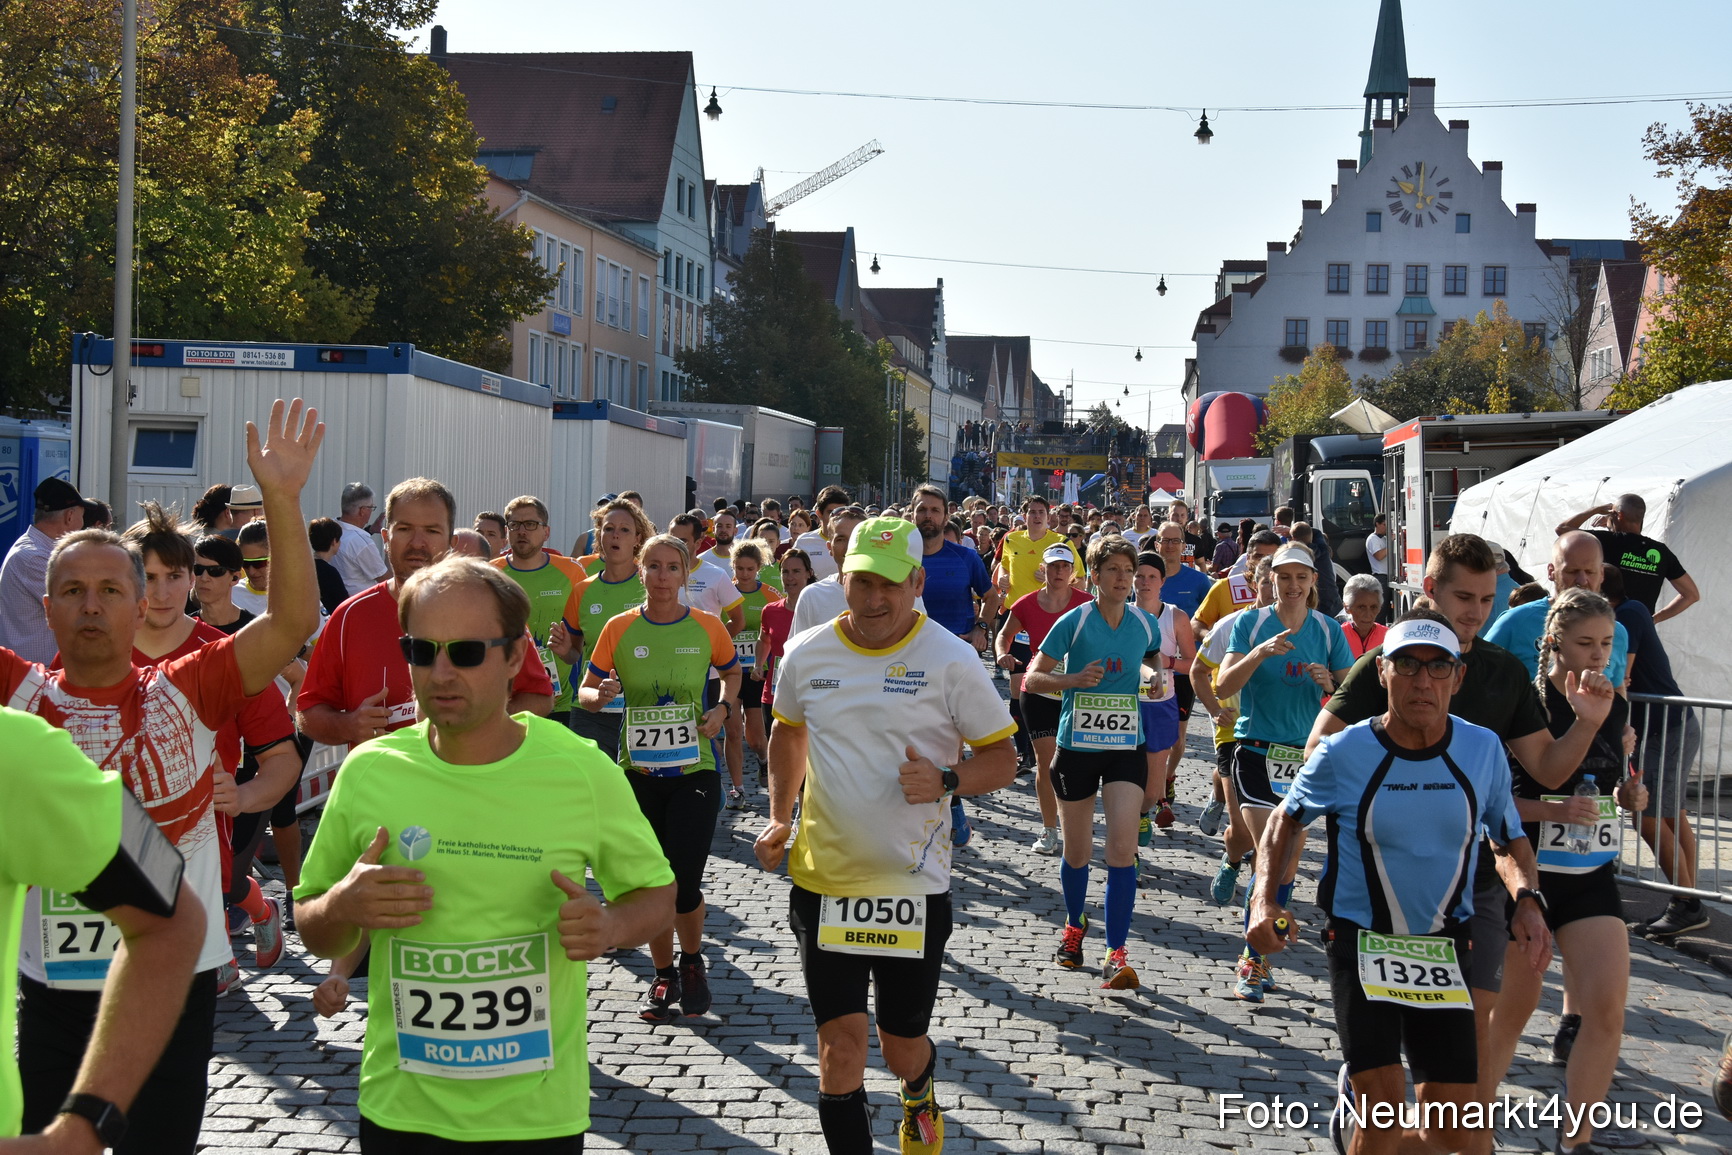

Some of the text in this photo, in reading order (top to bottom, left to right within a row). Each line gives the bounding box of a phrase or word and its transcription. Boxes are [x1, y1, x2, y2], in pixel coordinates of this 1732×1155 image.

[277, 352, 286, 360] 80
[1, 446, 12, 454] 80
[1032, 456, 1071, 467] START
[1621, 551, 1647, 563] physio
[1620, 559, 1657, 572] neumarkt
[1403, 631, 1439, 640] SPORTS
[1416, 623, 1440, 635] ultra
[887, 665, 907, 678] 20
[884, 678, 928, 688] Neumarkter
[882, 686, 919, 696] Stadtlauf
[1079, 695, 1133, 710] BOCK
[632, 707, 690, 723] BOCK
[1080, 712, 1131, 731] 2462
[635, 726, 690, 747] 2713
[1083, 734, 1126, 744] MELANIE
[437, 838, 544, 854] Freie katholische Volksschule
[446, 848, 462, 856] Haus
[472, 849, 496, 859] Marien,
[497, 852, 543, 863] Neumarkt/Opf.
[835, 896, 915, 926] 1050
[845, 931, 898, 945] BERND
[1367, 934, 1448, 961] BOCK
[401, 941, 535, 979] BOCK
[1373, 957, 1453, 987] 1328
[1387, 989, 1445, 1001] DIETER
[409, 985, 532, 1031] 2239
[424, 1041, 521, 1063] ROLAND
